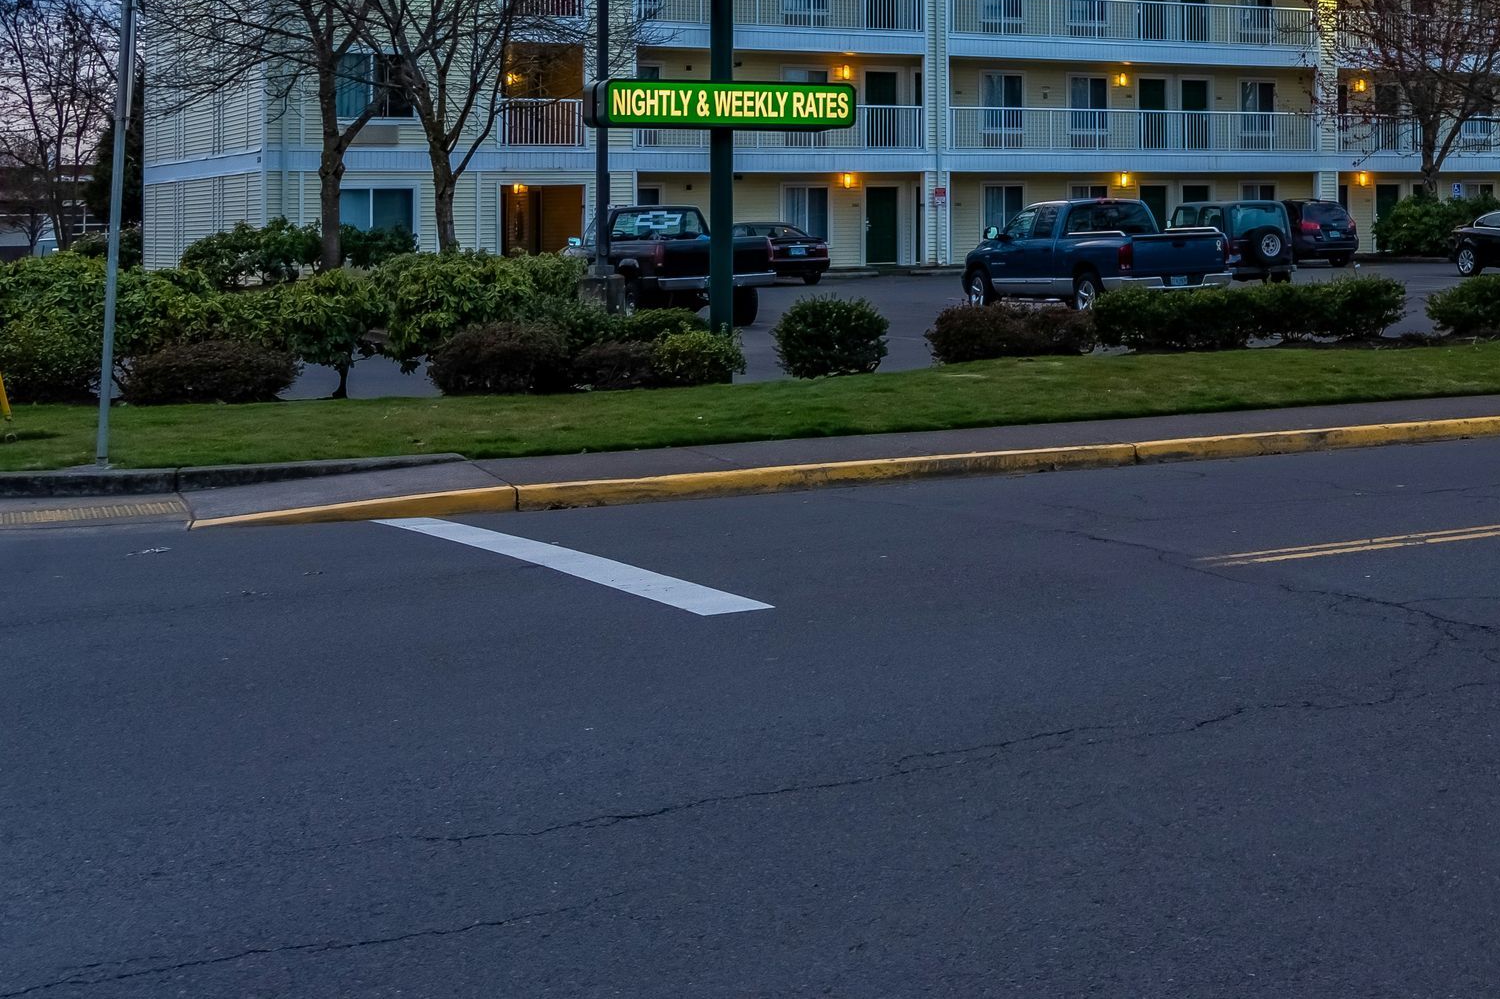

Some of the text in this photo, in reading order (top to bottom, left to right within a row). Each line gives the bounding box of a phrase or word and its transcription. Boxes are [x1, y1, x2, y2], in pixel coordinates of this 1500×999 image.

[612, 88, 849, 119] NIGHTLY & WEEKLY RATES
